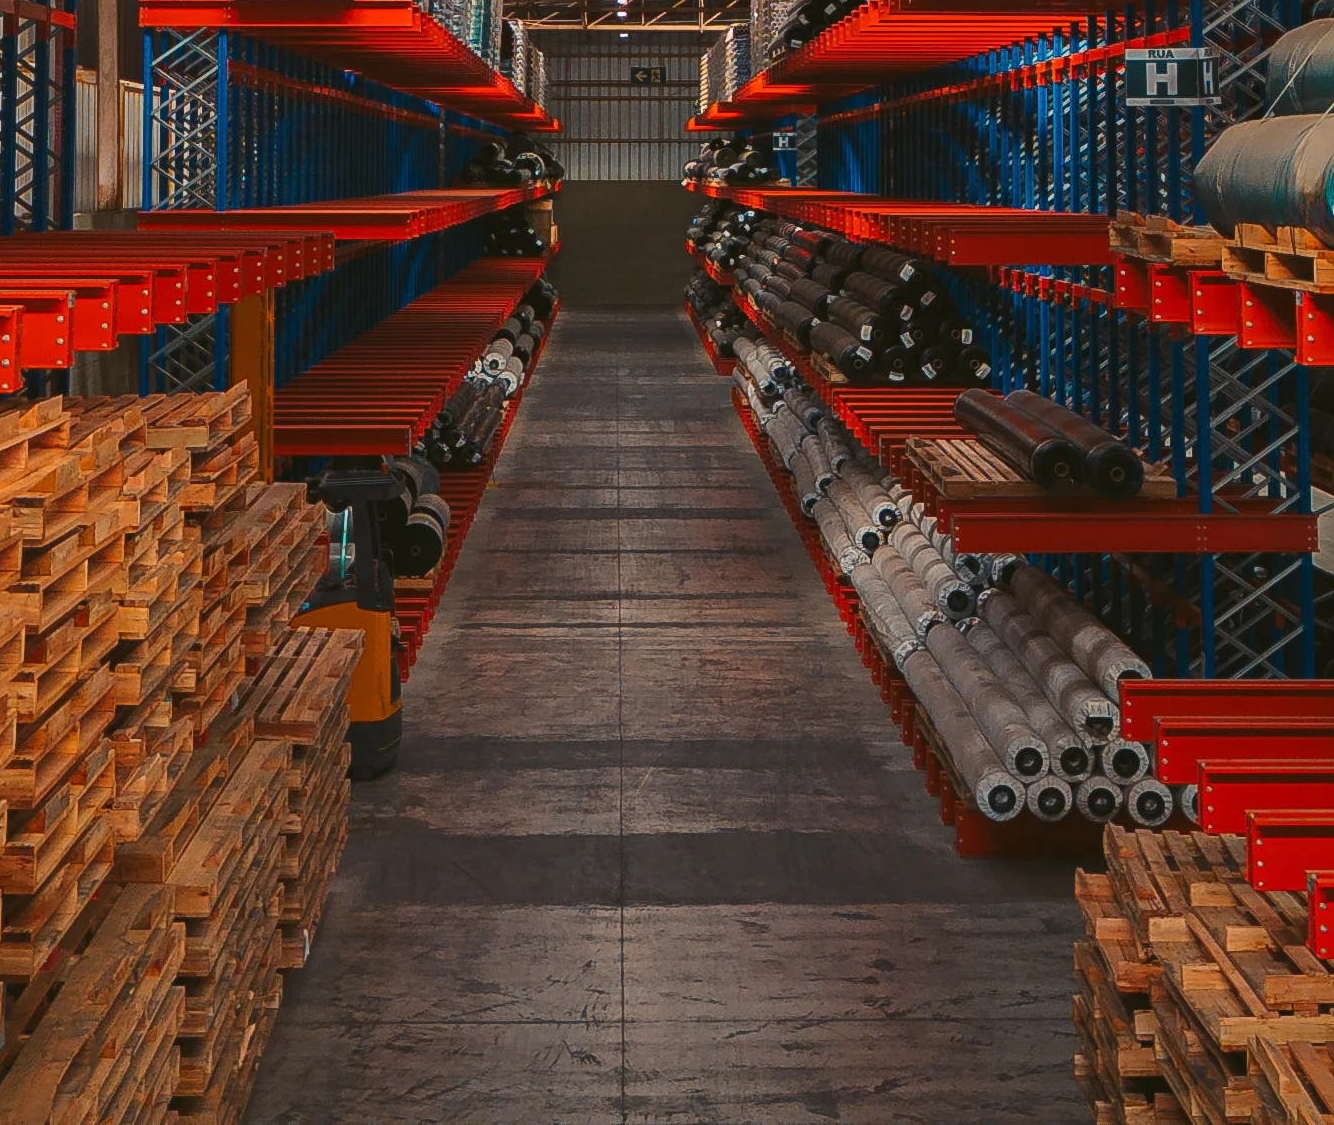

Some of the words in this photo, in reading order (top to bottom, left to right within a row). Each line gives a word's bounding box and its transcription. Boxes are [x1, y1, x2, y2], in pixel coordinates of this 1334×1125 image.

[1148, 50, 1174, 58] RUA
[1146, 62, 1178, 95] H
[1203, 61, 1214, 95] H
[779, 137, 789, 147] H
